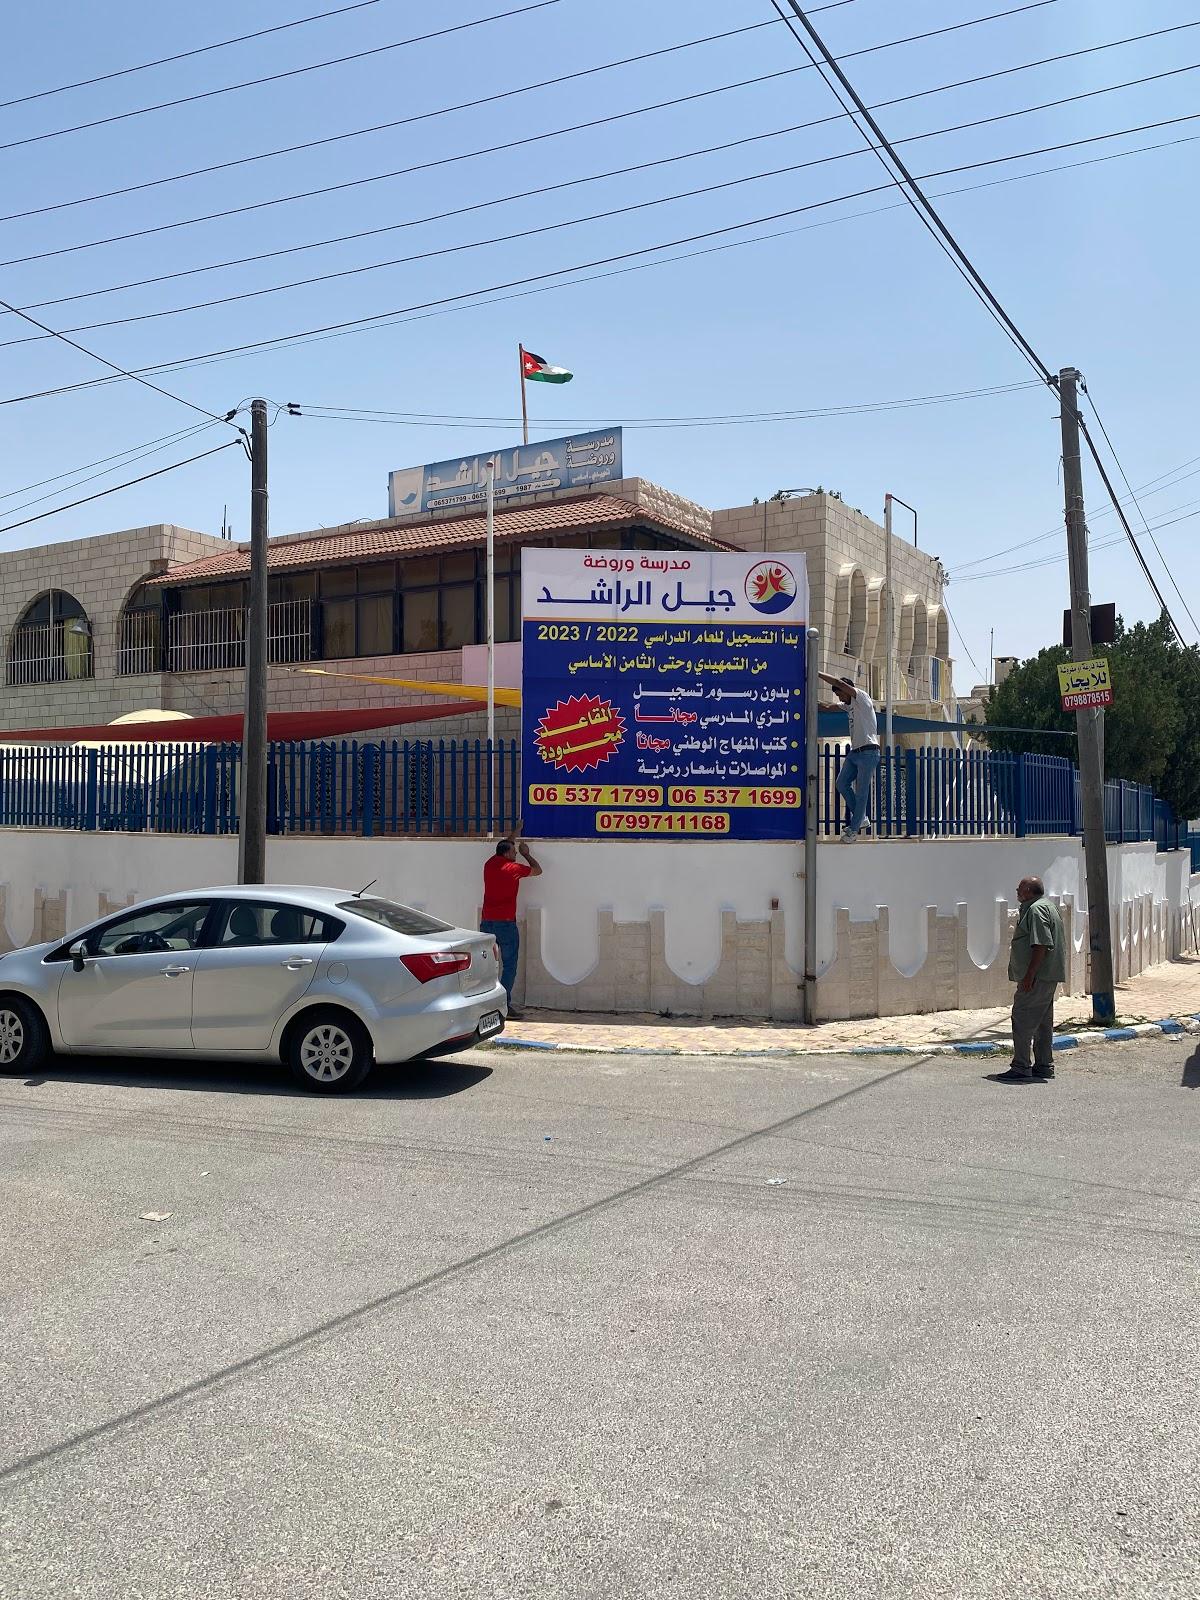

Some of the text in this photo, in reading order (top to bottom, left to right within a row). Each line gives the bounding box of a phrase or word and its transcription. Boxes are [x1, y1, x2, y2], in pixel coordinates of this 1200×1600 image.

[565, 436, 614, 453] مدرسة
[565, 452, 615, 468] وروضة
[427, 449, 560, 493] جيل الراشد
[471, 489, 506, 500] 0653699
[516, 484, 531, 492] 1987
[584, 555, 690, 572] مدرسة وروضة
[537, 578, 736, 612] جيل الراشد
[538, 624, 799, 649] بدأ التسجيل للعام الدراسي 2022 / 2023
[568, 652, 768, 676] من التمهيدي وحتى الثامن الأساسي
[633, 683, 790, 702] بدون رسوم تسجيل
[1064, 691, 1110, 707] 0798878515
[540, 706, 612, 738] المقاعد
[700, 710, 753, 729] المدرسي
[756, 710, 789, 729] الزي
[539, 730, 622, 760] محدودة
[672, 734, 716, 756] الوطني
[719, 736, 758, 754] المنهاج
[762, 736, 788, 754] كتب
[637, 758, 786, 780] المواصلات بأسعار رمزية
[533, 787, 659, 804] 06 537 1799
[672, 789, 796, 804] 06 537 1699
[600, 814, 726, 830] 0799711168
